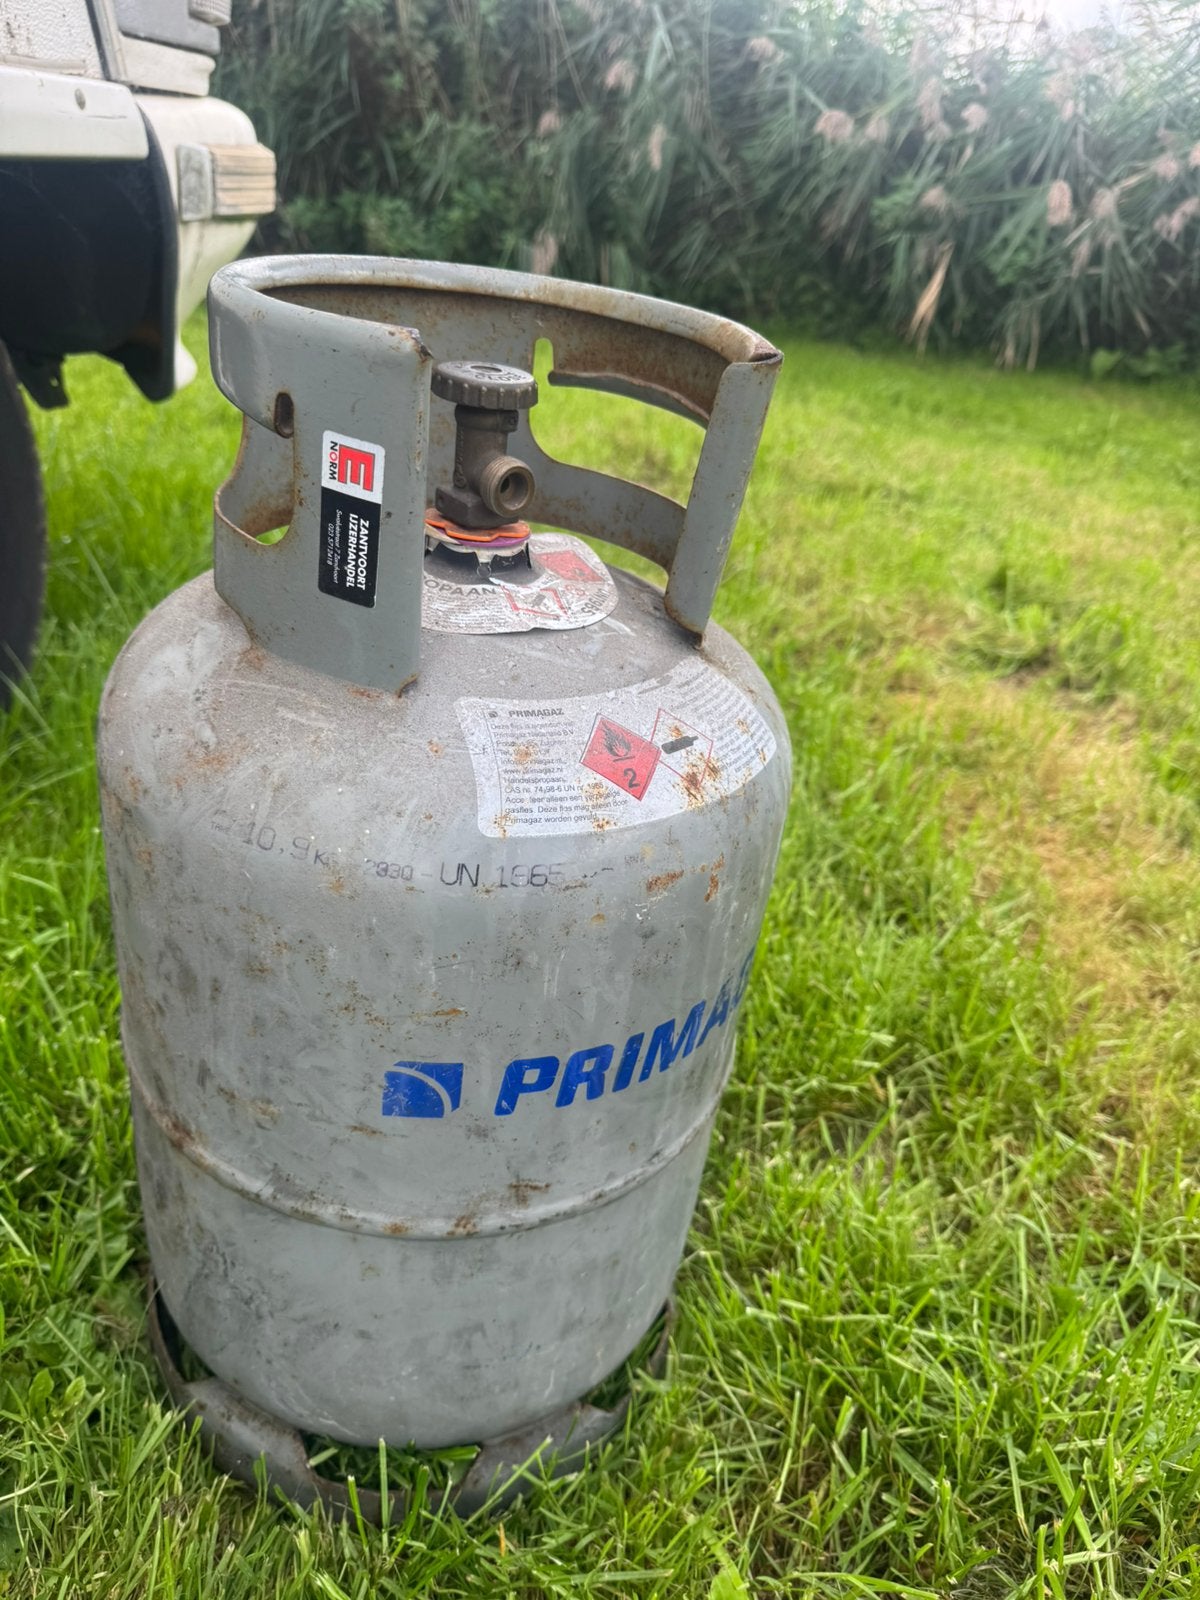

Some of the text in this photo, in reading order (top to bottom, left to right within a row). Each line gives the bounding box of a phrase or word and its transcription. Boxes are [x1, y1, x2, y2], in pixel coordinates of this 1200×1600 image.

[328, 440, 339, 481] NORM
[337, 443, 376, 493] E
[346, 513, 358, 588] IJZERHANDEL
[356, 518, 370, 591] ZANTVOORT
[333, 553, 341, 584] Zandvoort
[424, 578, 497, 596] OPAAN
[508, 707, 565, 718] PRIMAGAZ
[505, 786, 521, 794] CAS
[564, 784, 575, 792] UN
[622, 767, 641, 788] 2
[504, 814, 542, 824] Primagaz
[544, 814, 572, 823] worden
[440, 861, 480, 888] UN
